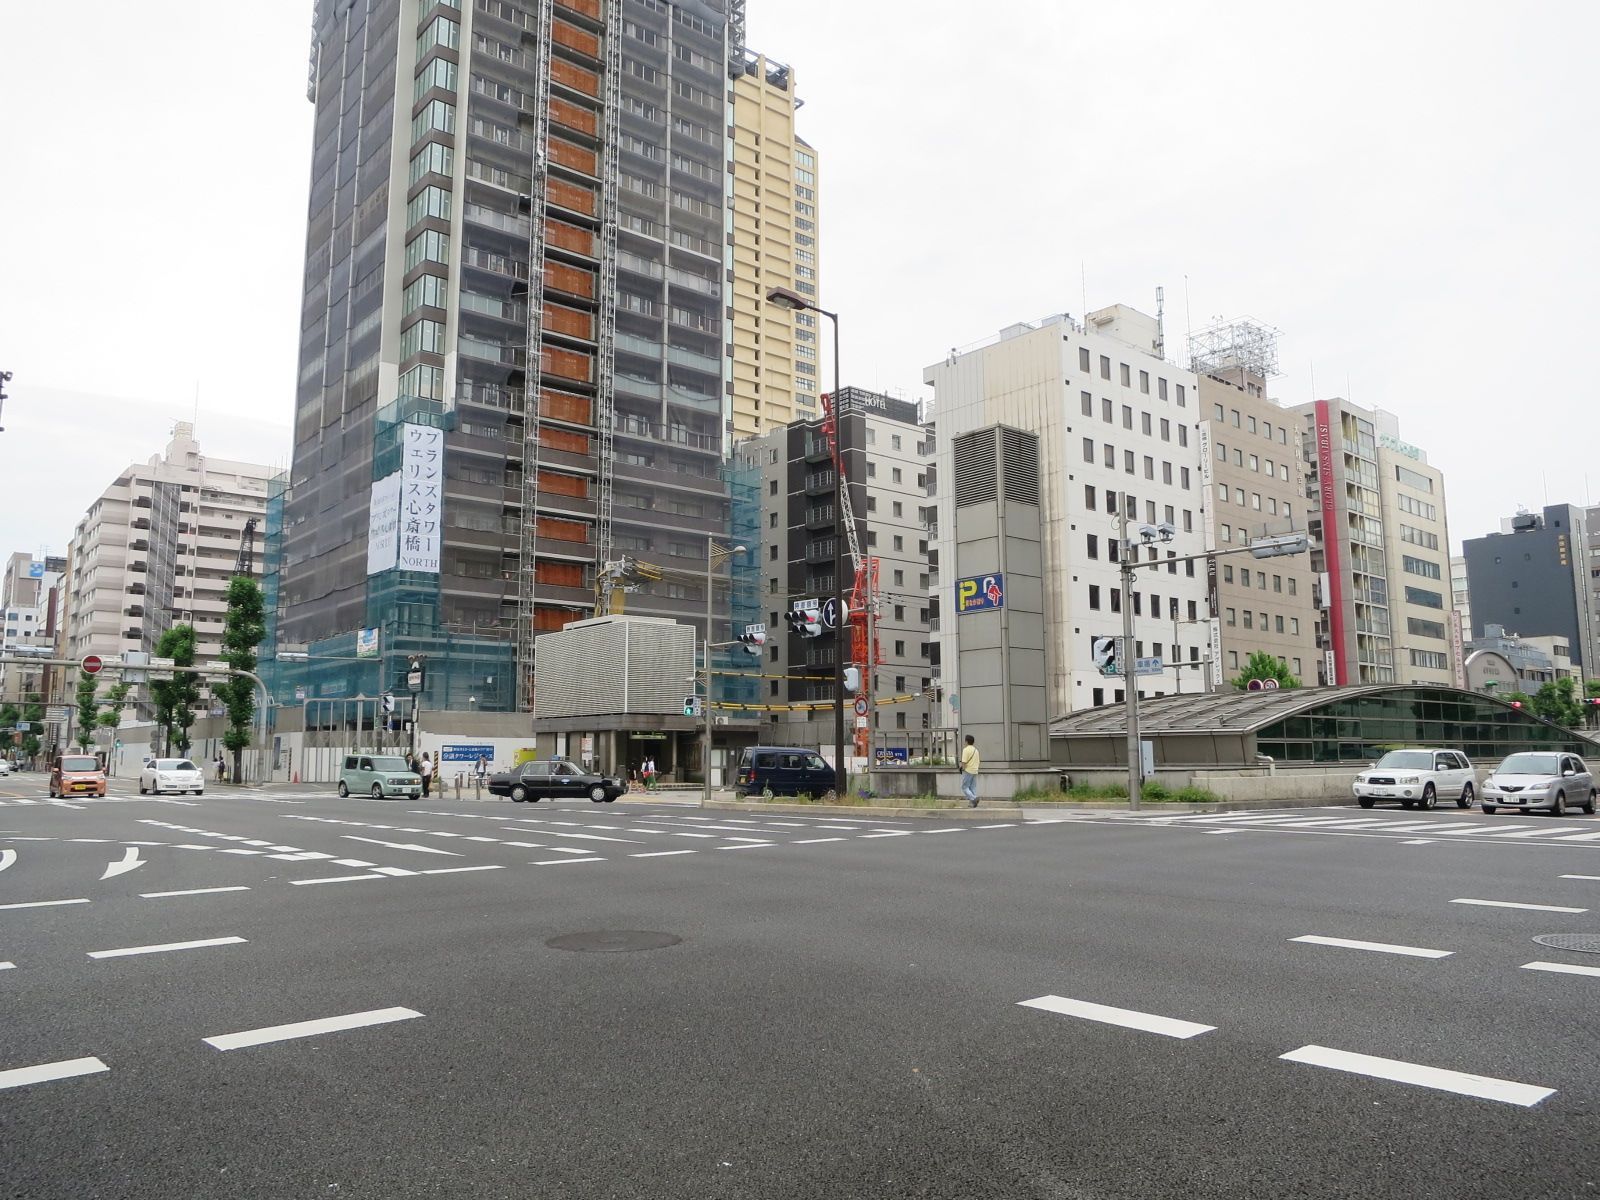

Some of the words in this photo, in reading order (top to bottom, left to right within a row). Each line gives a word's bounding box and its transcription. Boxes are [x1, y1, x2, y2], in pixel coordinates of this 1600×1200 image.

[865, 396, 887, 409] HOTEL
[405, 429, 424, 552] ウェリス心斎橋
[424, 431, 440, 552] ブランズタワー
[402, 556, 438, 568] NORTH
